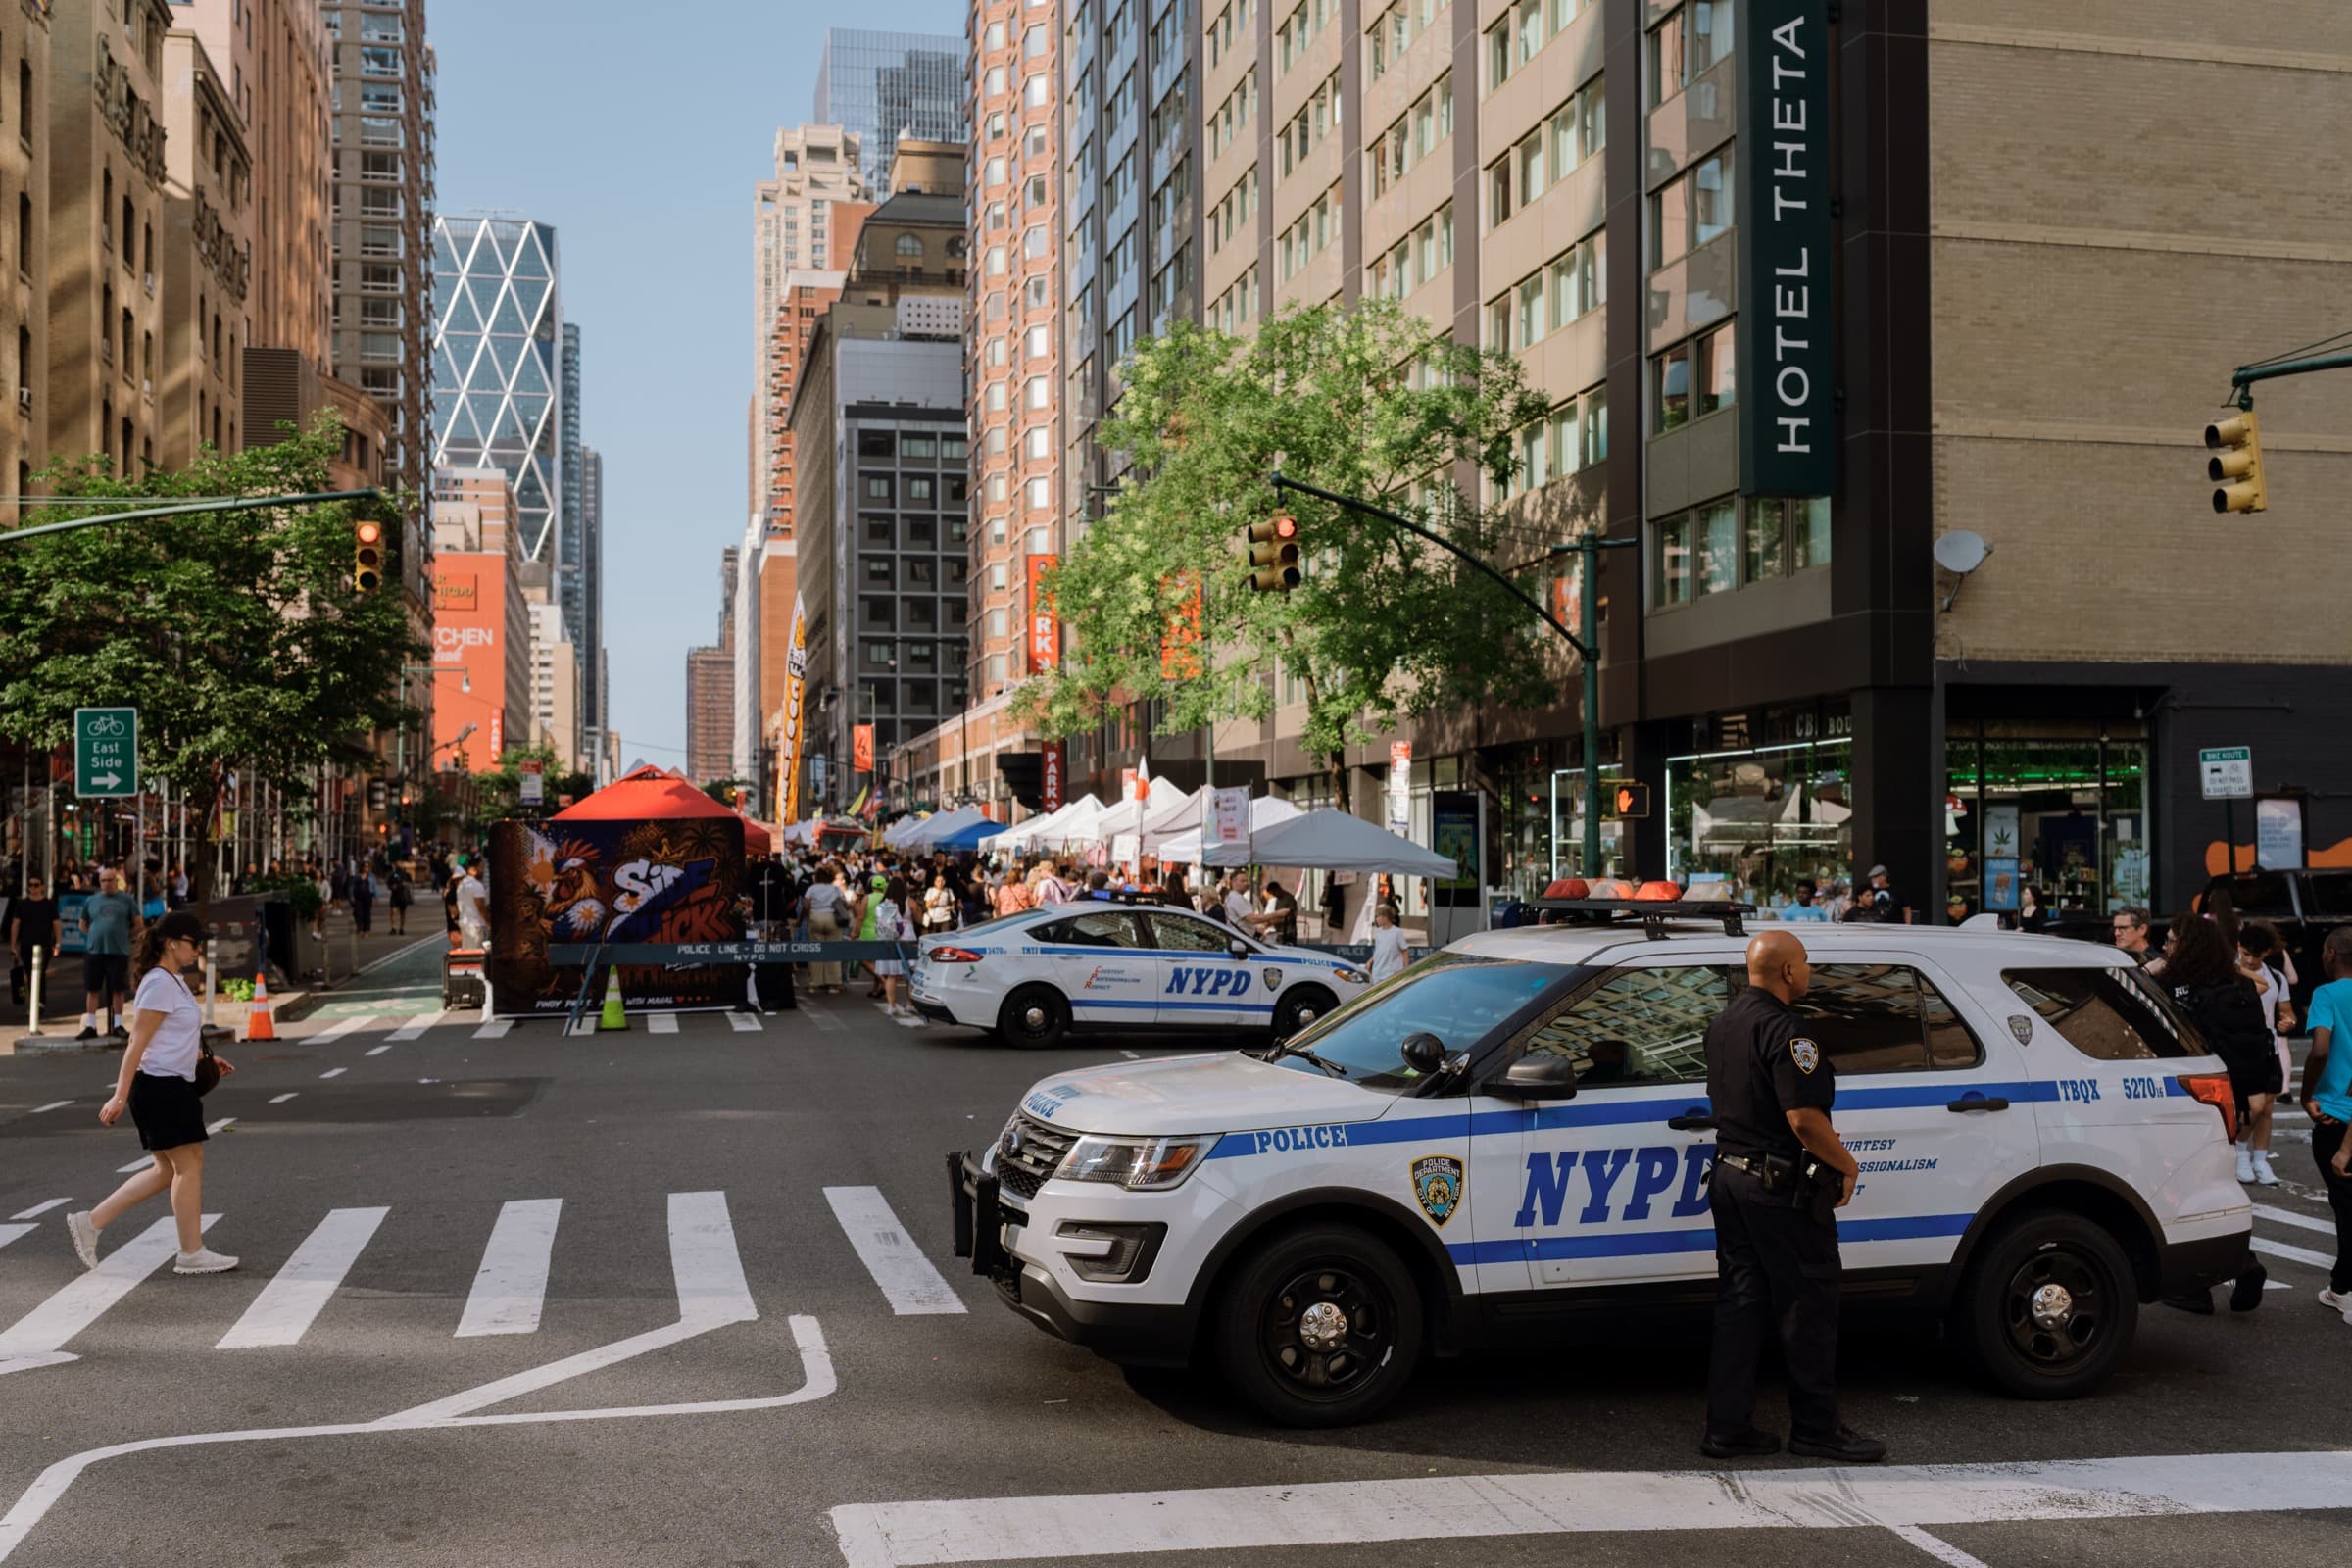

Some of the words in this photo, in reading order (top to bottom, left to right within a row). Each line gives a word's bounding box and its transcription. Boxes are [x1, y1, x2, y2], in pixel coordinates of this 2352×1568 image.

[1771, 15, 1807, 221] THETA
[1775, 247, 1811, 453] HOTEL
[93, 741, 120, 754] East
[91, 756, 122, 768] Side
[1046, 751, 1058, 799] PARK
[677, 944, 710, 955] POLICE
[717, 943, 738, 955] LINE
[753, 943, 765, 954] DO
[768, 943, 787, 954] NOT
[790, 942, 822, 954] CROSS
[1302, 957, 1332, 967] POLICE
[1164, 967, 1252, 997] NYPD
[2059, 1079, 2101, 1104] TBQX
[2122, 1076, 2156, 1099] 5270
[1024, 1092, 1063, 1119] POLICE
[1255, 1124, 1346, 1154] POLICE
[1842, 1138, 1896, 1152] URTESY
[1414, 1165, 1460, 1180] DEPARTMENT
[1422, 1157, 1451, 1168] POLICE
[1857, 1158, 1938, 1173] SSIONALISM
[1514, 1143, 1717, 1227] NYPD
[1417, 1187, 1428, 1204] CITY
[1426, 1206, 1436, 1216] OF
[1444, 1201, 1455, 1218] NEW
